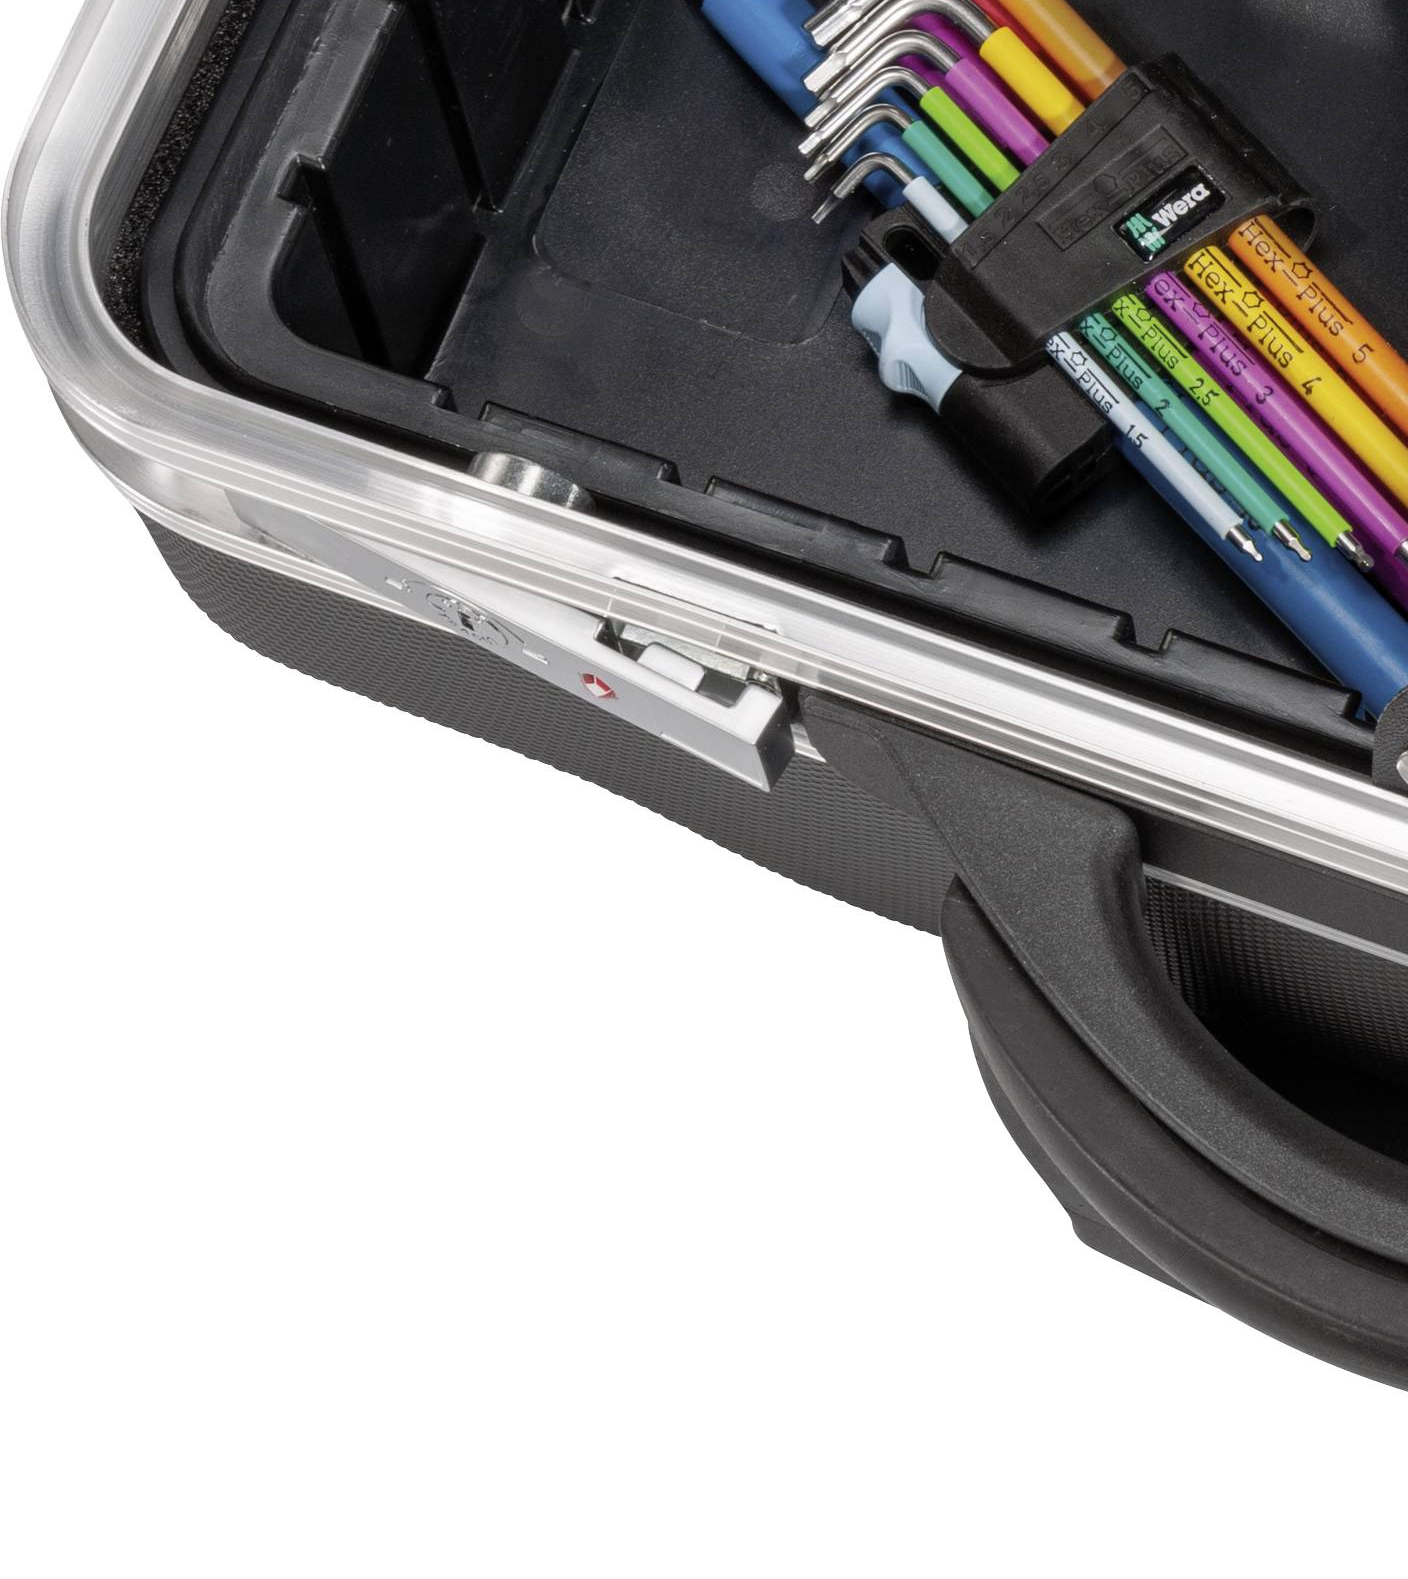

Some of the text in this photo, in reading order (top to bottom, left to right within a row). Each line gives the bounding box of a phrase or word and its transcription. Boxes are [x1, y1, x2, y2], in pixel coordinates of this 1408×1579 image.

[1152, 183, 1211, 227] Wera
[1187, 252, 1239, 305] Hex
[1245, 314, 1298, 369] Plus
[1299, 372, 1324, 397] 4
[1237, 219, 1374, 365] Hex Plus 5
[1139, 325, 1182, 371] Plus
[1151, 274, 1188, 312] ex
[1196, 323, 1250, 378] Plus
[1252, 383, 1276, 406] 3
[1075, 370, 1116, 415] Plus
[1104, 345, 1146, 389] Plus
[1152, 396, 1174, 418] 2
